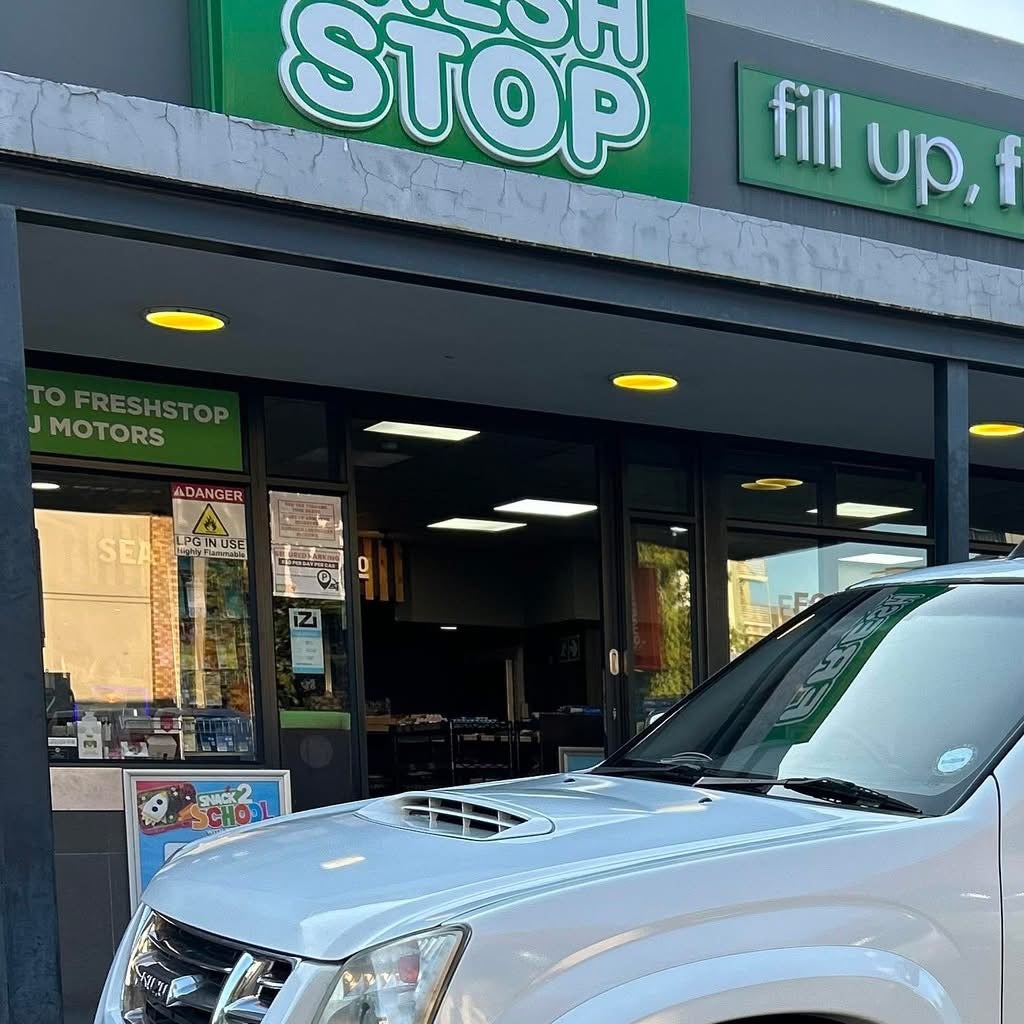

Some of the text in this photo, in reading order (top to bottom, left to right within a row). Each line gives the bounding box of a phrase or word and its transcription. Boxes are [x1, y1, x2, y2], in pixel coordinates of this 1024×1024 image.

[279, 0, 651, 177] STOP
[769, 79, 842, 170] fill
[867, 121, 980, 207] up,
[28, 384, 230, 425] TO FRESHSTOP
[50, 416, 165, 447] MOTORS
[185, 486, 243, 502] DANGER
[176, 535, 246, 550] LPG IN USE
[176, 547, 246, 559] Highly Flammable
[198, 783, 253, 807] SNACK 2
[191, 800, 272, 830] SCHOOL
